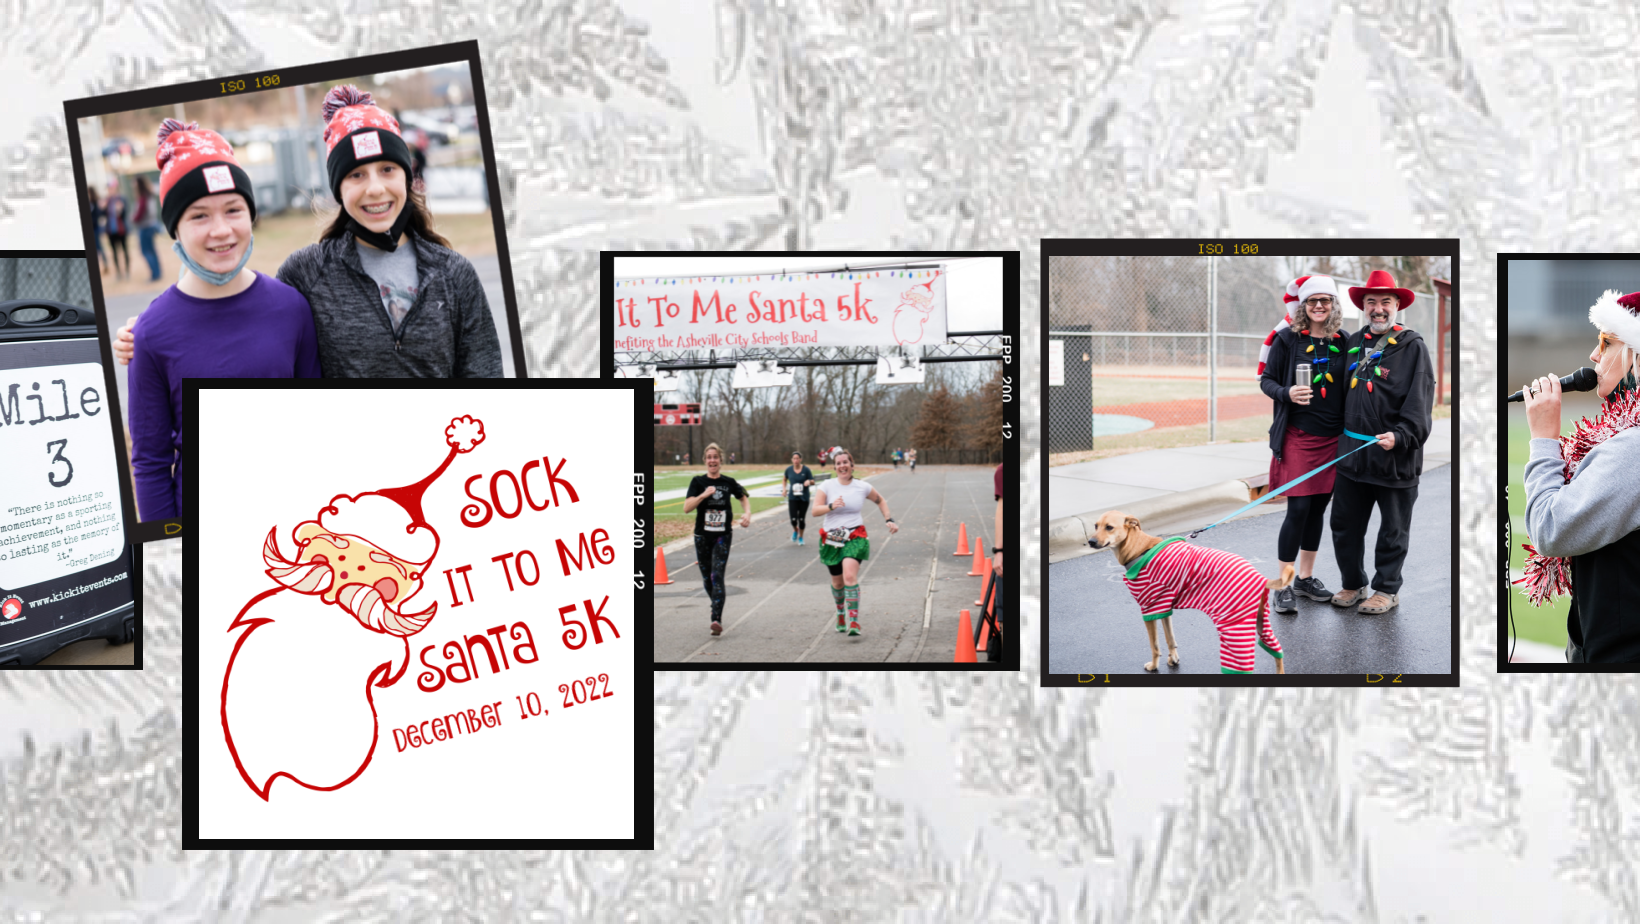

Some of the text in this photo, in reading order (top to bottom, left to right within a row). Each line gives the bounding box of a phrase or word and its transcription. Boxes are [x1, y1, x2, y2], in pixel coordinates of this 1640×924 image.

[615, 282, 879, 328] It To Me Santa 5k
[657, 334, 674, 348] the
[676, 333, 723, 348] Asheville
[725, 333, 750, 349] City
[751, 331, 789, 346] Schools
[791, 330, 818, 344] Band
[0, 379, 101, 427] Mile
[47, 438, 74, 488] 3
[0, 515, 53, 533] momentary
[55, 512, 66, 521] as
[75, 501, 112, 517] sporting
[44, 501, 55, 511] is
[57, 493, 93, 507] nothing
[94, 491, 104, 499] so
[708, 514, 723, 522] 977
[65, 520, 82, 532] and
[83, 513, 116, 528] nothing
[9, 543, 49, 560] lasting
[51, 539, 62, 549] as
[63, 535, 79, 545] the
[80, 526, 110, 541] memory
[111, 522, 120, 532] of
[28, 571, 129, 609] www.kickitevents.com
